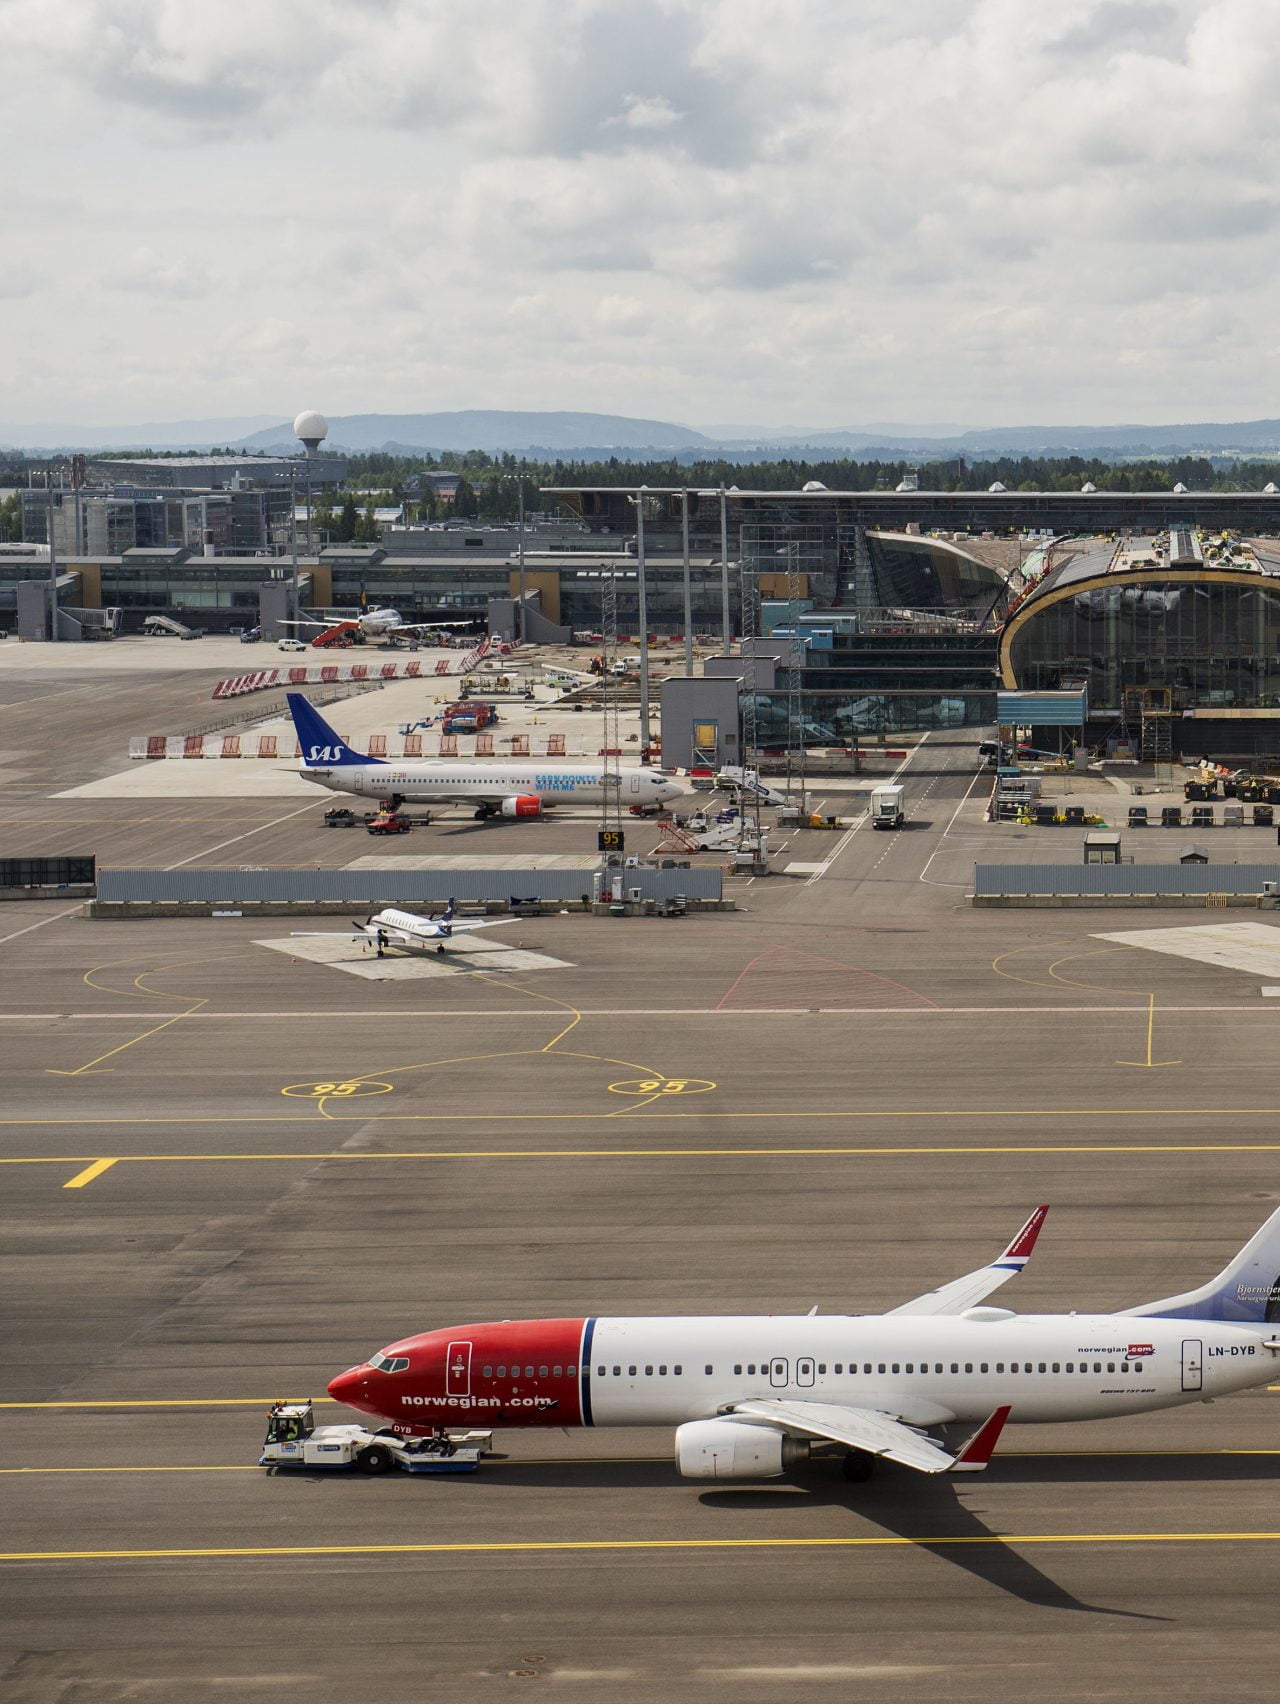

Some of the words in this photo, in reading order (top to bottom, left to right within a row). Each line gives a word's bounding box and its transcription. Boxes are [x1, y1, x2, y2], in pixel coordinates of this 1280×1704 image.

[306, 746, 344, 761] SAS
[535, 783, 559, 791] WITH
[603, 832, 619, 844] 95
[311, 1084, 362, 1096] 95
[638, 1081, 688, 1093] 95
[1208, 1346, 1256, 1357] LN-DYB
[393, 1425, 412, 1434] DYB
